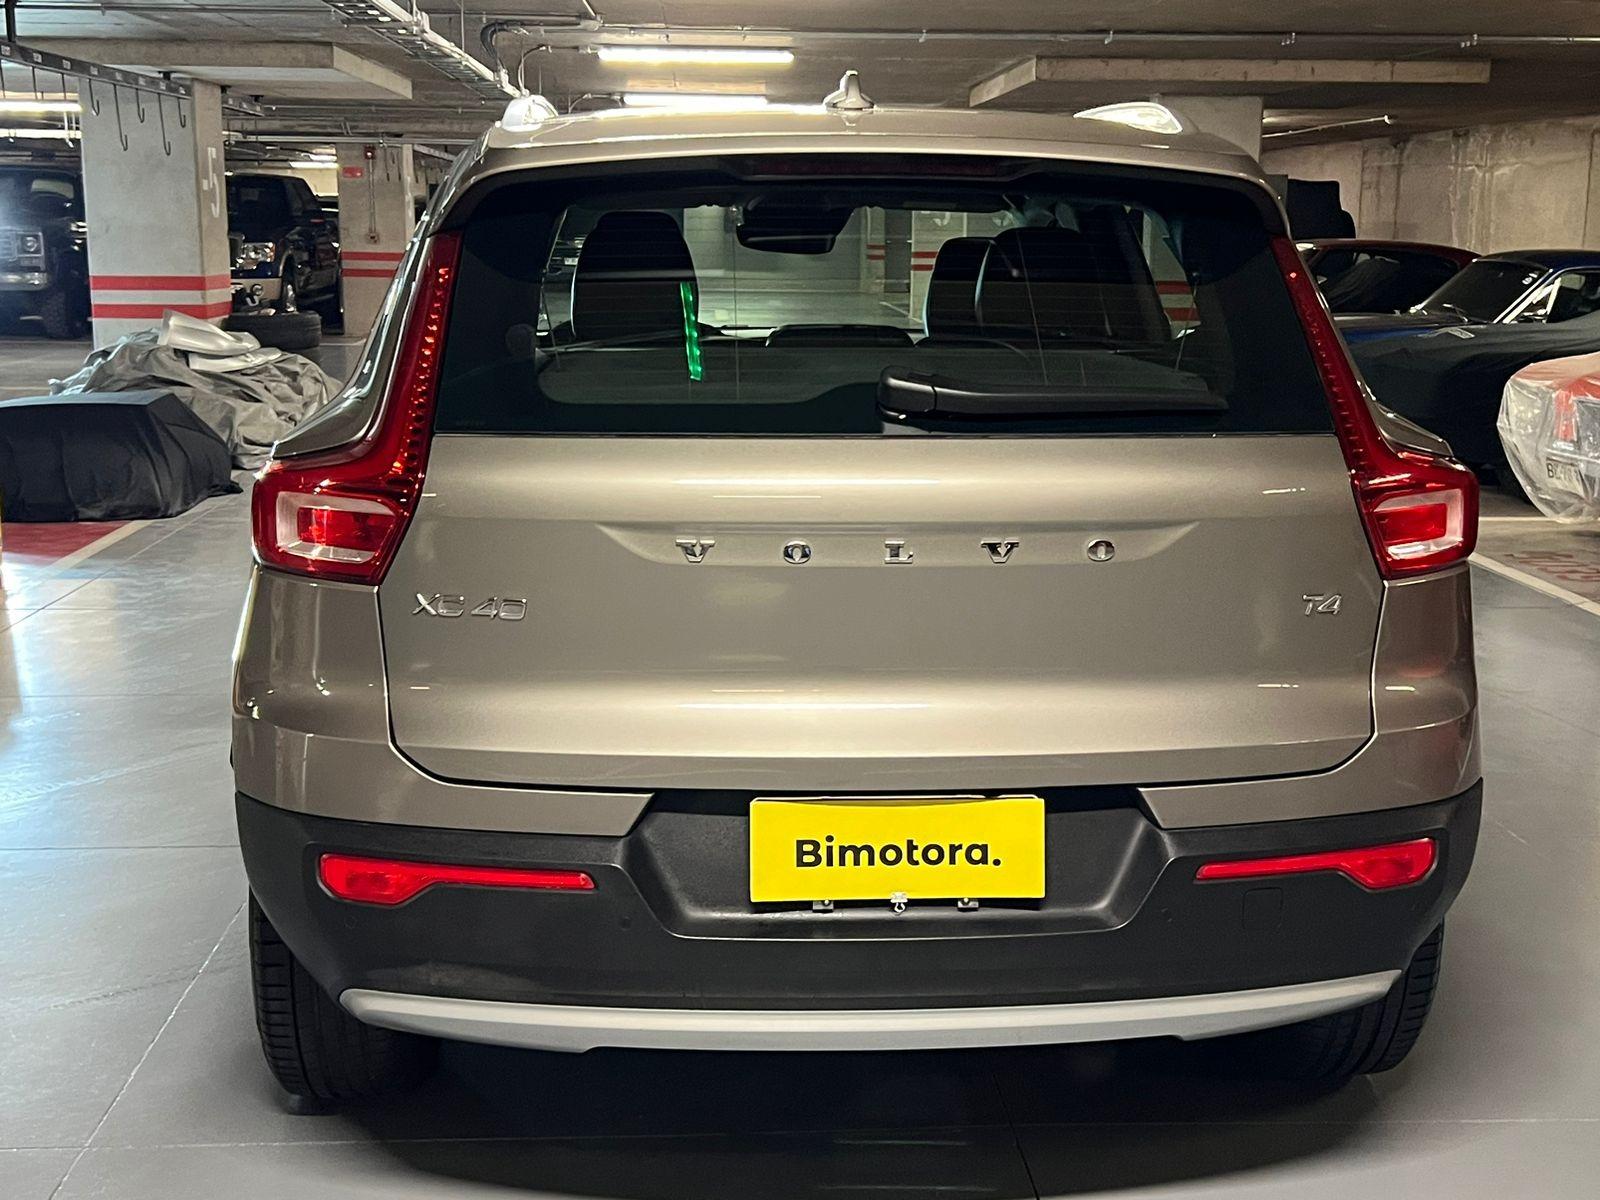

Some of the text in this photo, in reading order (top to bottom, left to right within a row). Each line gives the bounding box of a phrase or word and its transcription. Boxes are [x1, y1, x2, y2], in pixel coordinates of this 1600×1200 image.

[675, 538, 1115, 564] VOLVO
[1302, 594, 1342, 616] T4
[795, 834, 1002, 868] Bimotora.
